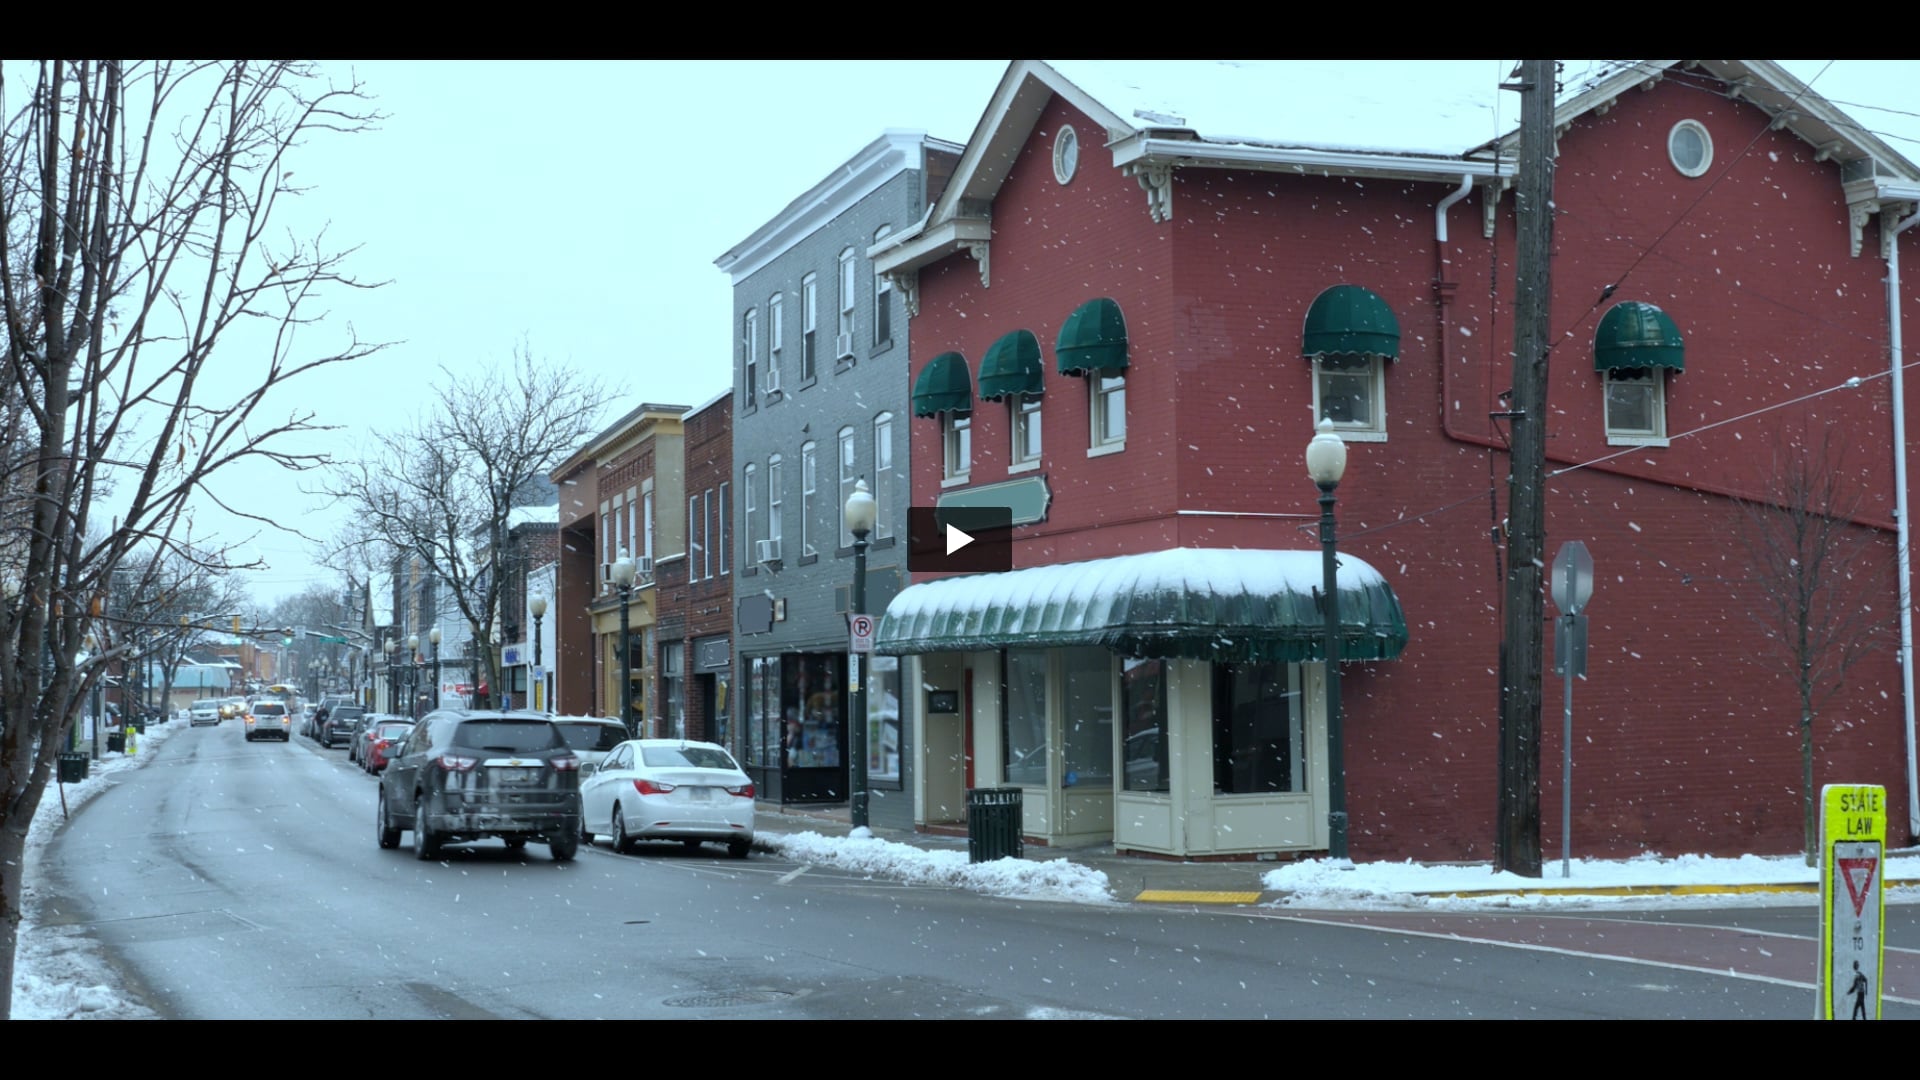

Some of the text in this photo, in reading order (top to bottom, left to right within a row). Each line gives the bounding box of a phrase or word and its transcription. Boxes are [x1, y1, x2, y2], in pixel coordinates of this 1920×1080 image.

[1841, 794, 1878, 812] STATE
[1847, 818, 1872, 835] LAW
[1852, 937, 1863, 950] TO
